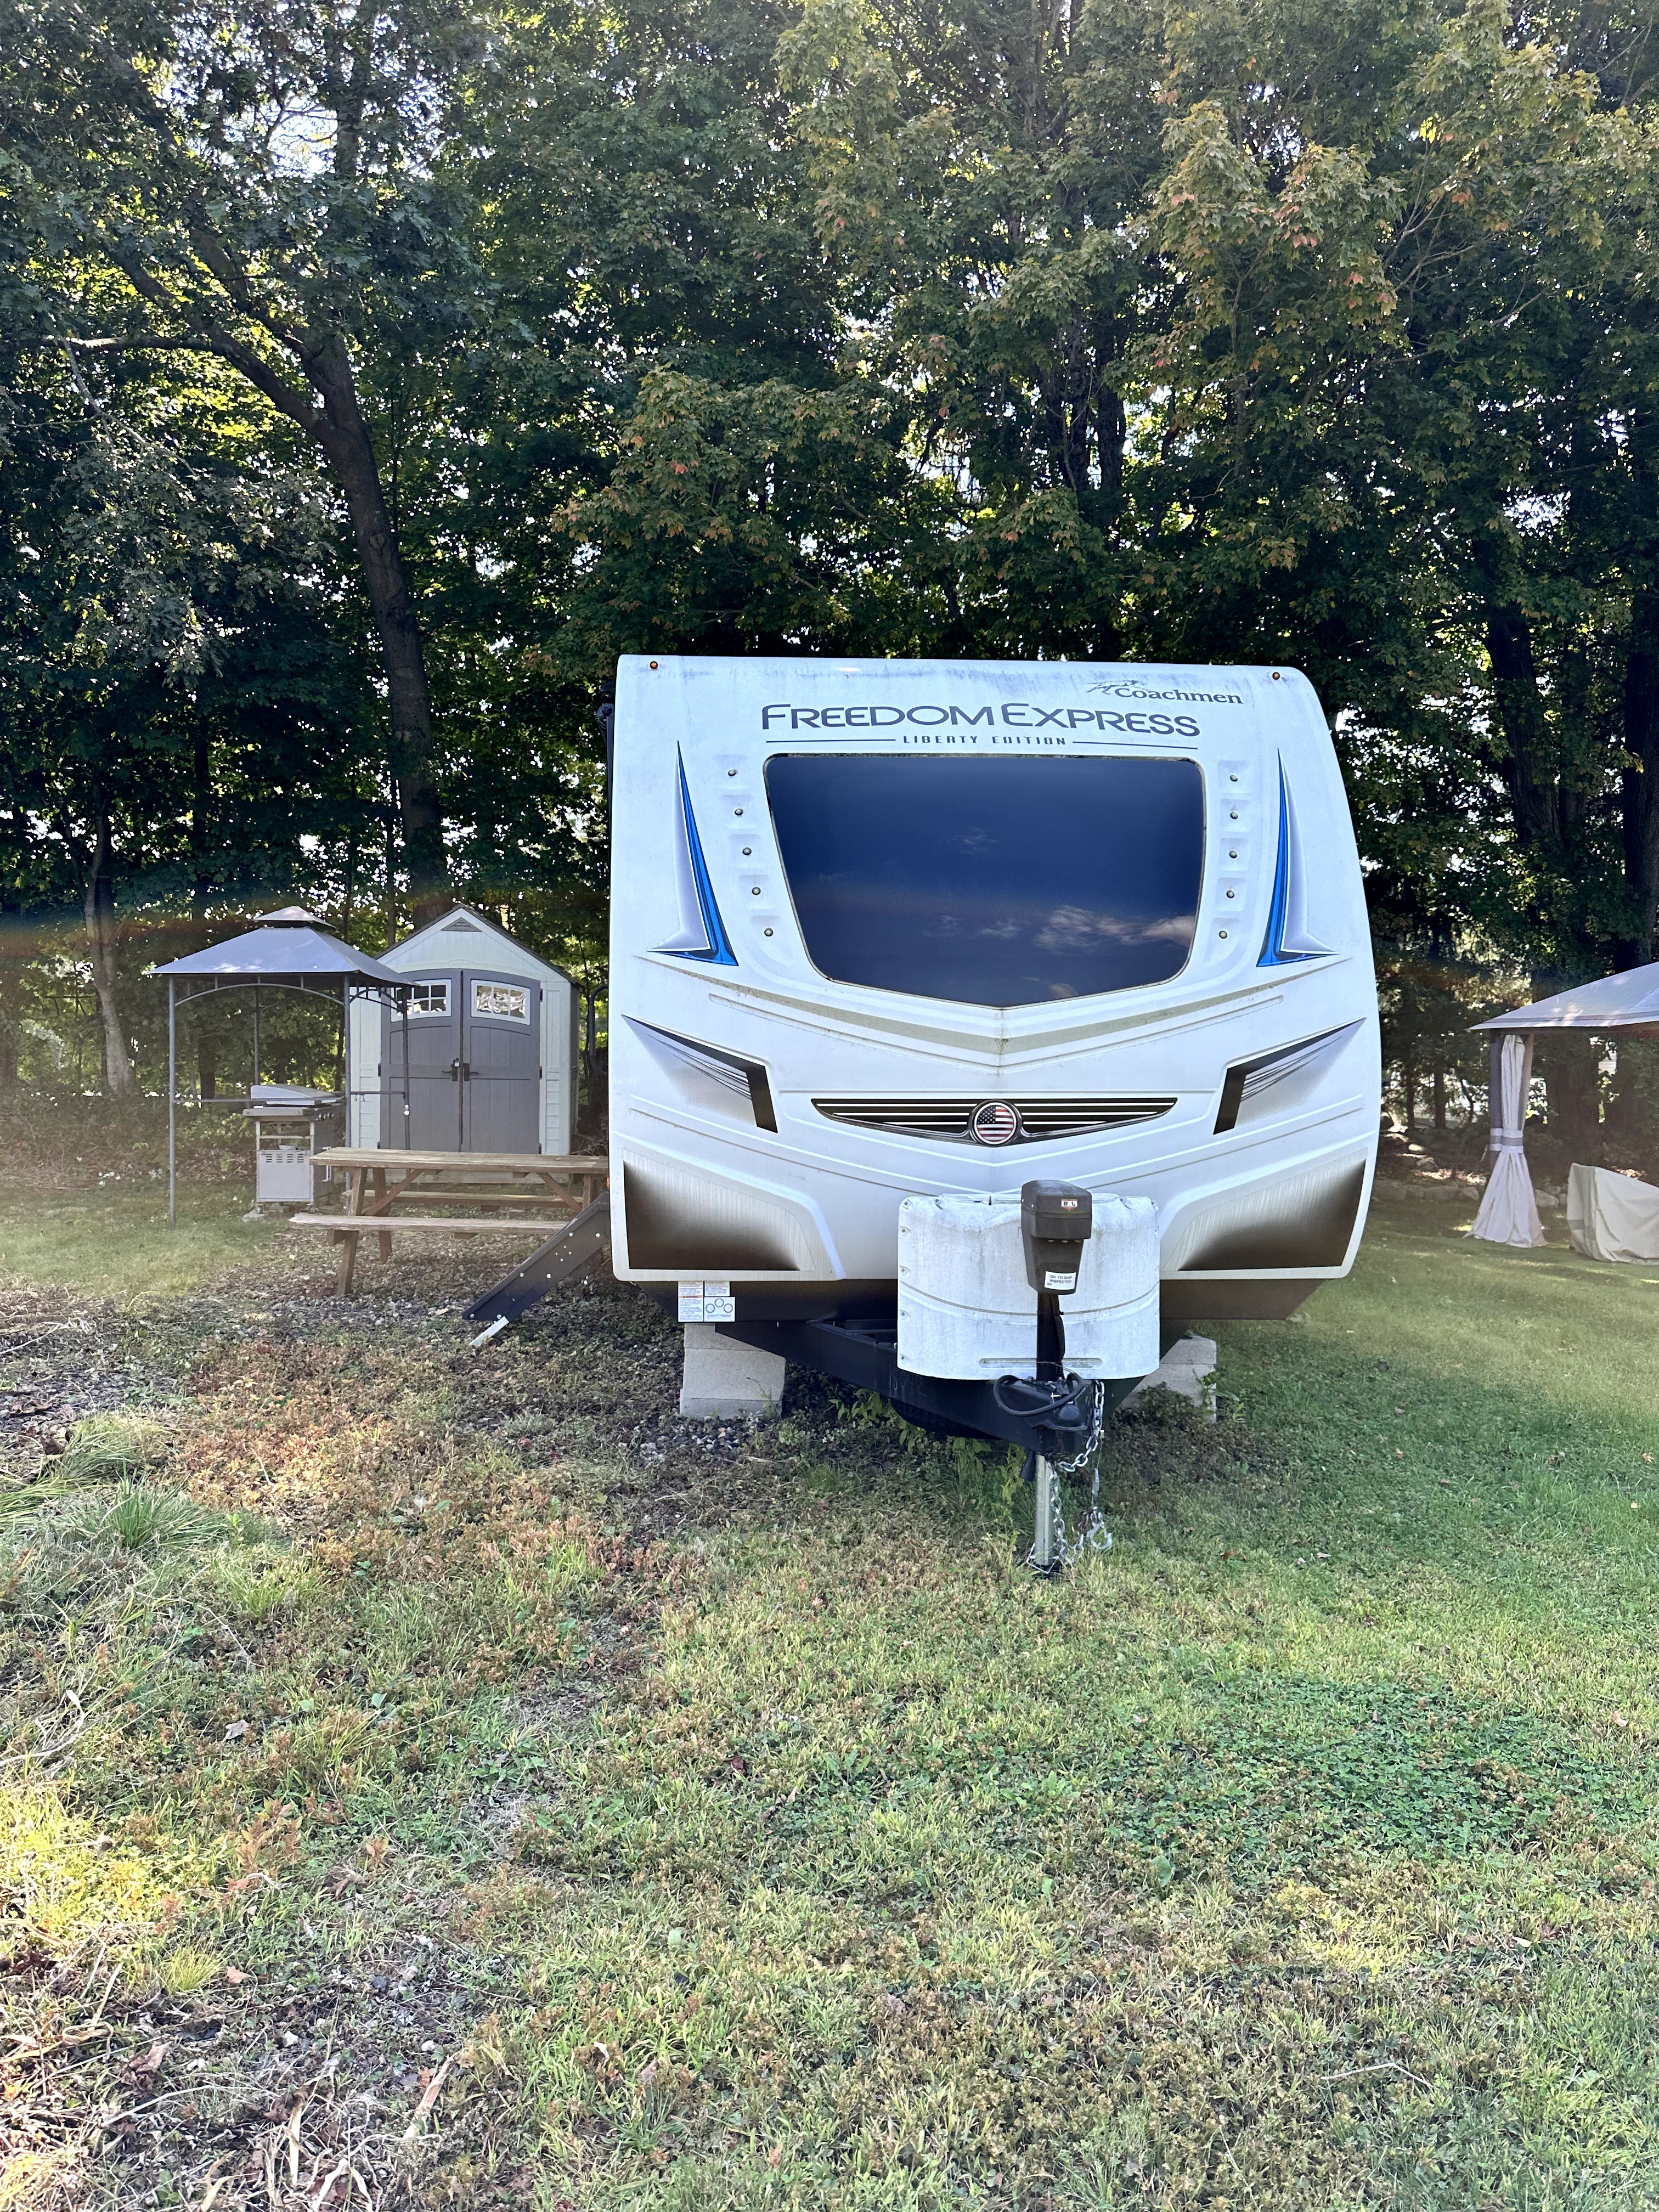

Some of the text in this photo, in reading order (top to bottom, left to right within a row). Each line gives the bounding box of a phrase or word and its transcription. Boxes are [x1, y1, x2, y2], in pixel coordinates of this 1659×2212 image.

[1114, 687, 1244, 704] Coachmen
[761, 702, 1200, 737] FREEDOM EXPRESS
[903, 735, 1066, 746] LIBERTY EDITION
